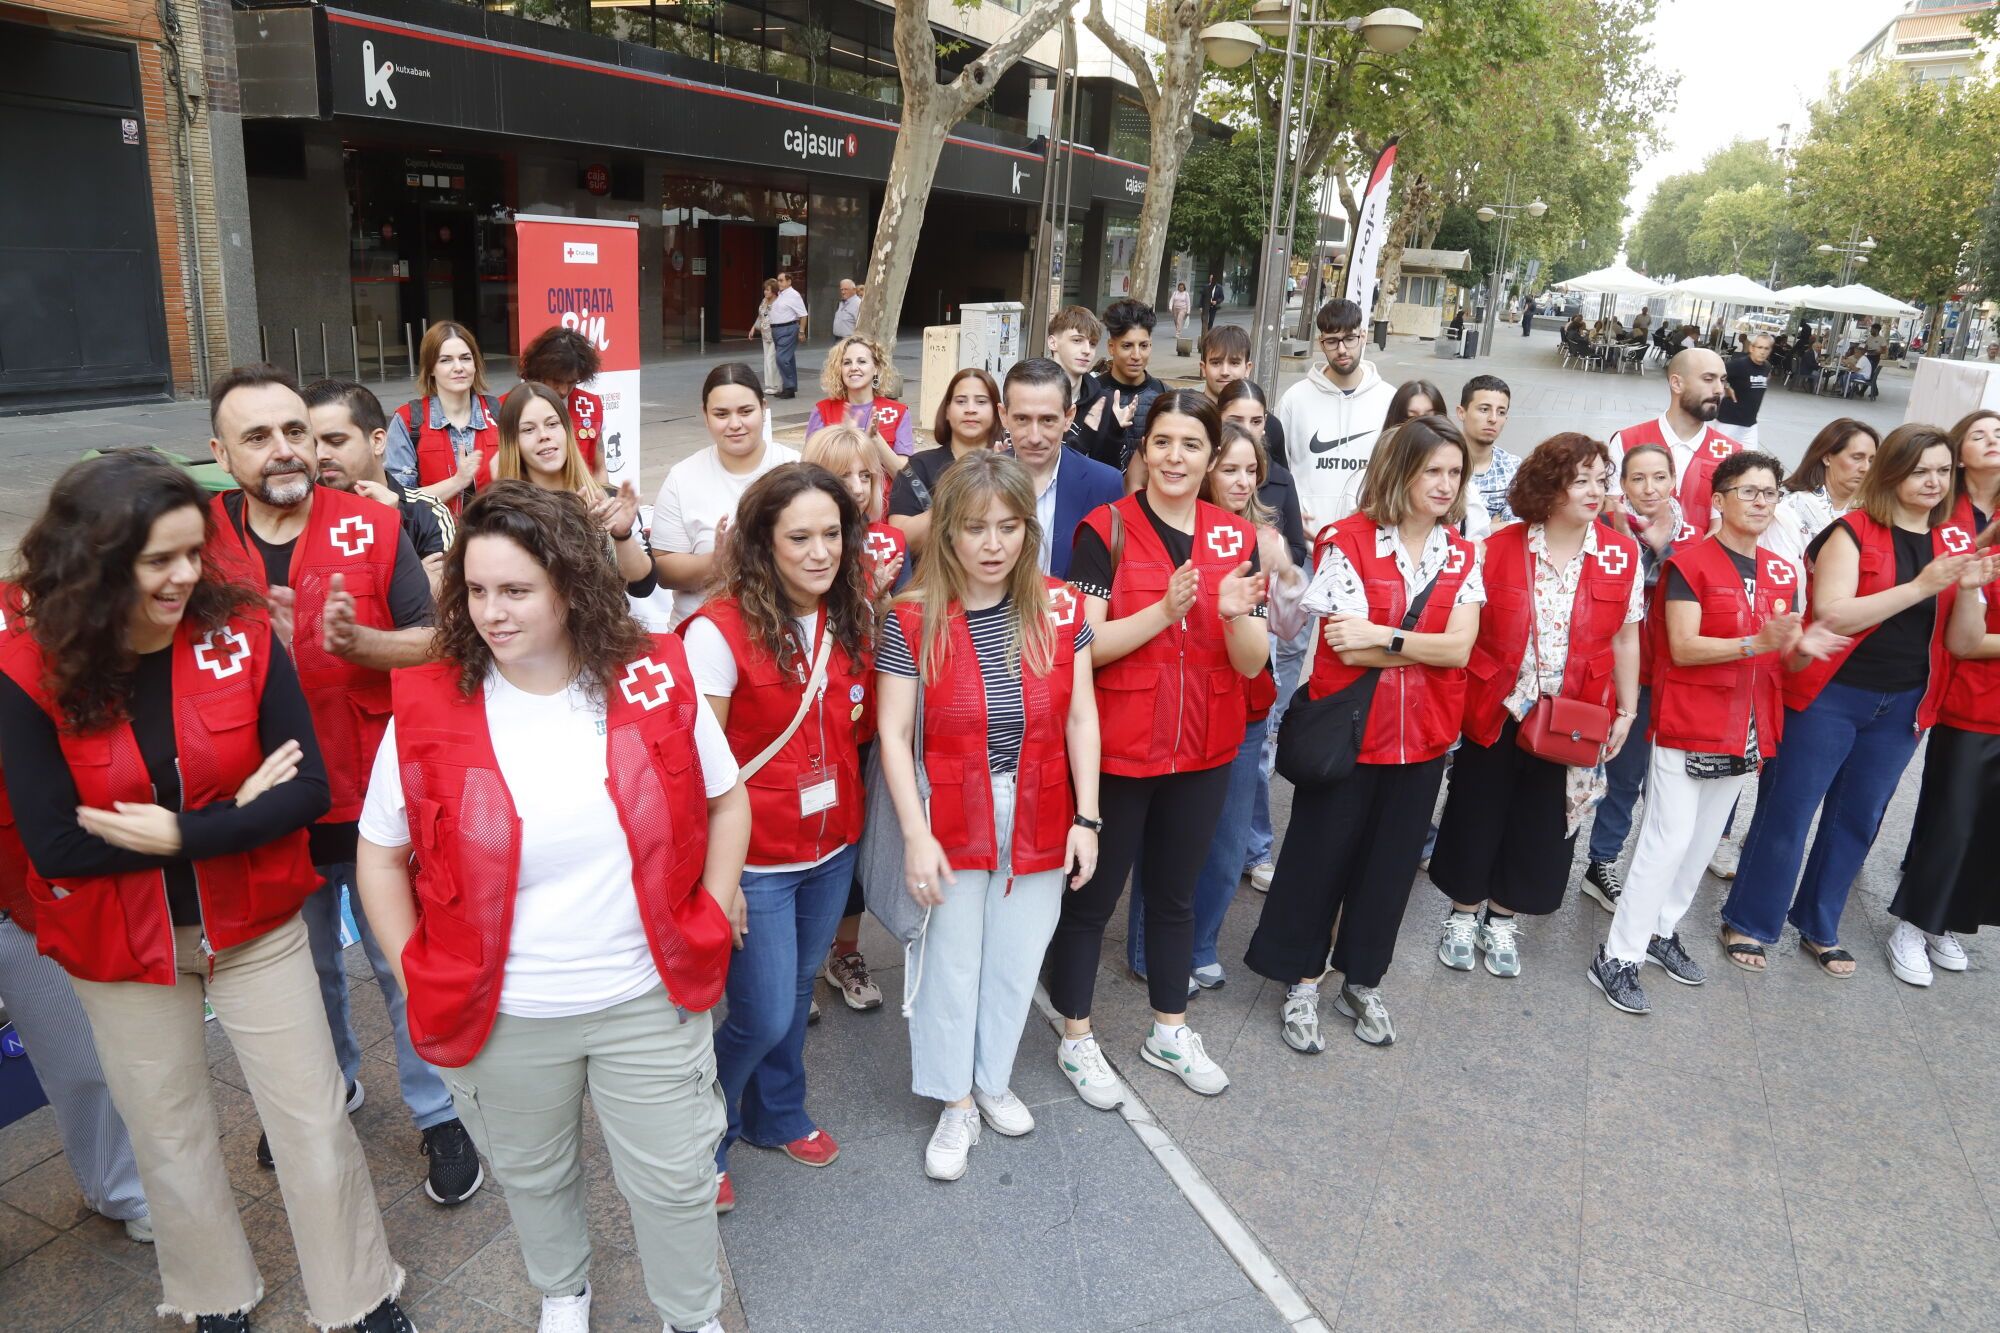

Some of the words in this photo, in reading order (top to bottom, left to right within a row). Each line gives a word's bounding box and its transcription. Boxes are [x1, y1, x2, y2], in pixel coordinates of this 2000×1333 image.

[395, 63, 431, 78] kutxabank
[784, 124, 845, 159] cajasur
[587, 170, 606, 182] caja
[547, 288, 614, 314] CONTRATA
[1316, 457, 1340, 470] JUST
[1341, 458, 1357, 470] DO
[1686, 759, 1715, 772] Desigual
